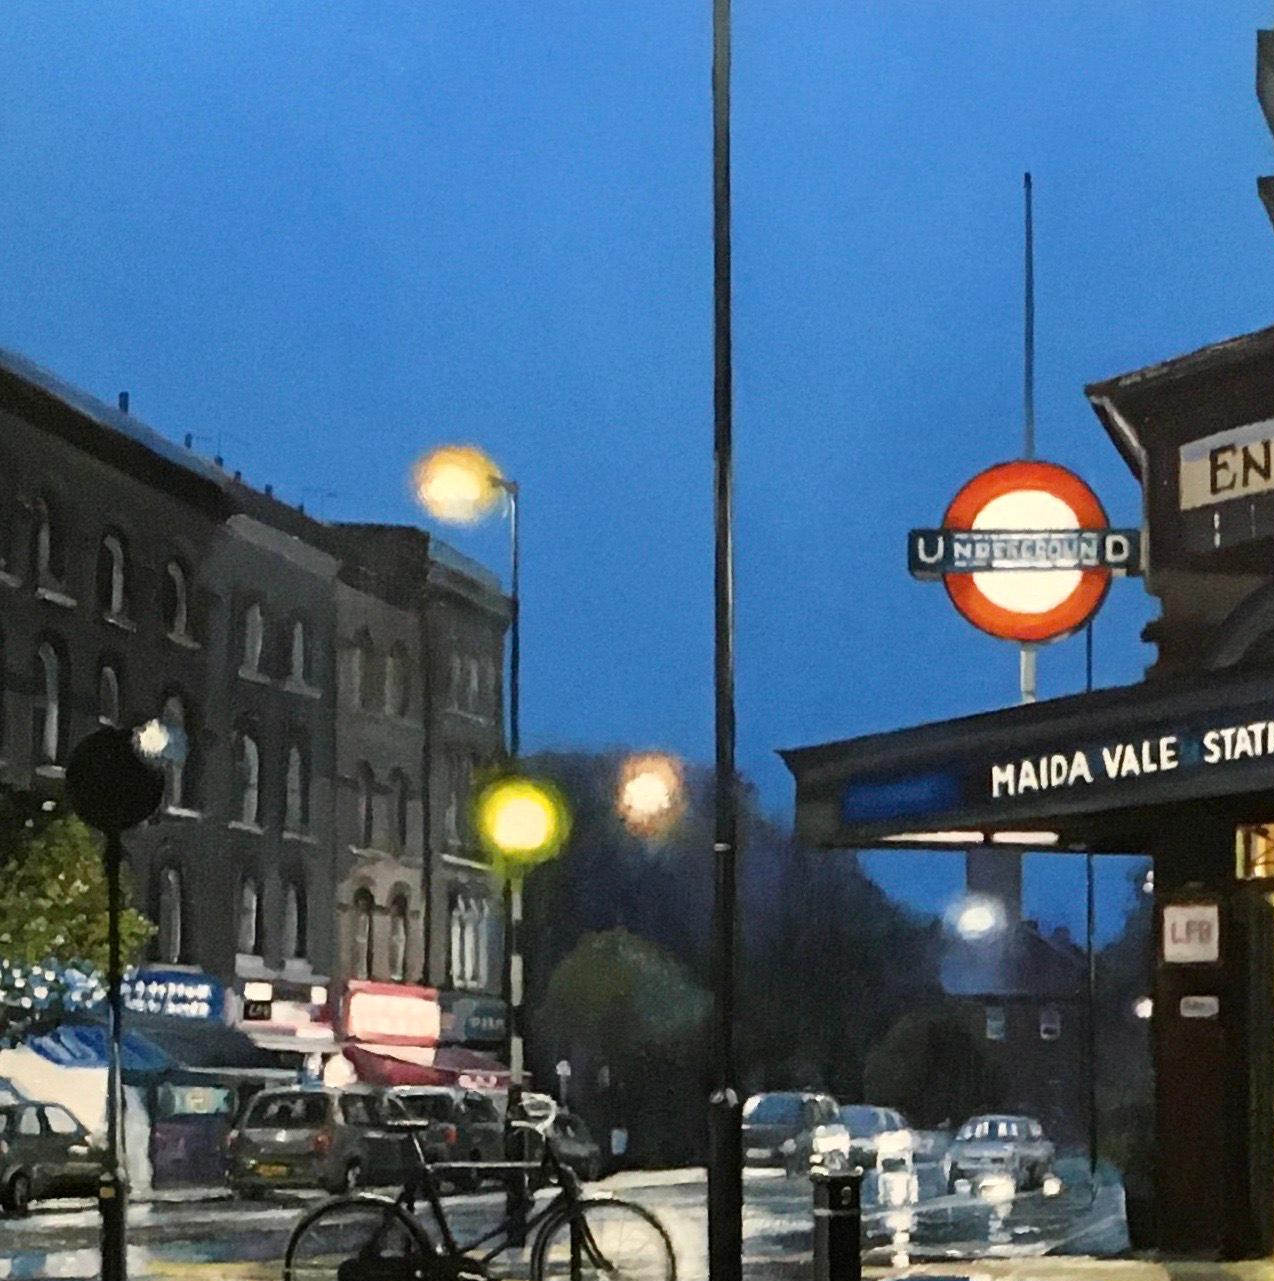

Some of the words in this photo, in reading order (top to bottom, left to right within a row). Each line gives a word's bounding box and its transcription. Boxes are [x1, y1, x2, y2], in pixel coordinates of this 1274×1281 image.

[917, 533, 1130, 564] UNDERGROUND
[991, 747, 1093, 798] MAIDA
[1101, 735, 1180, 780] VALE
